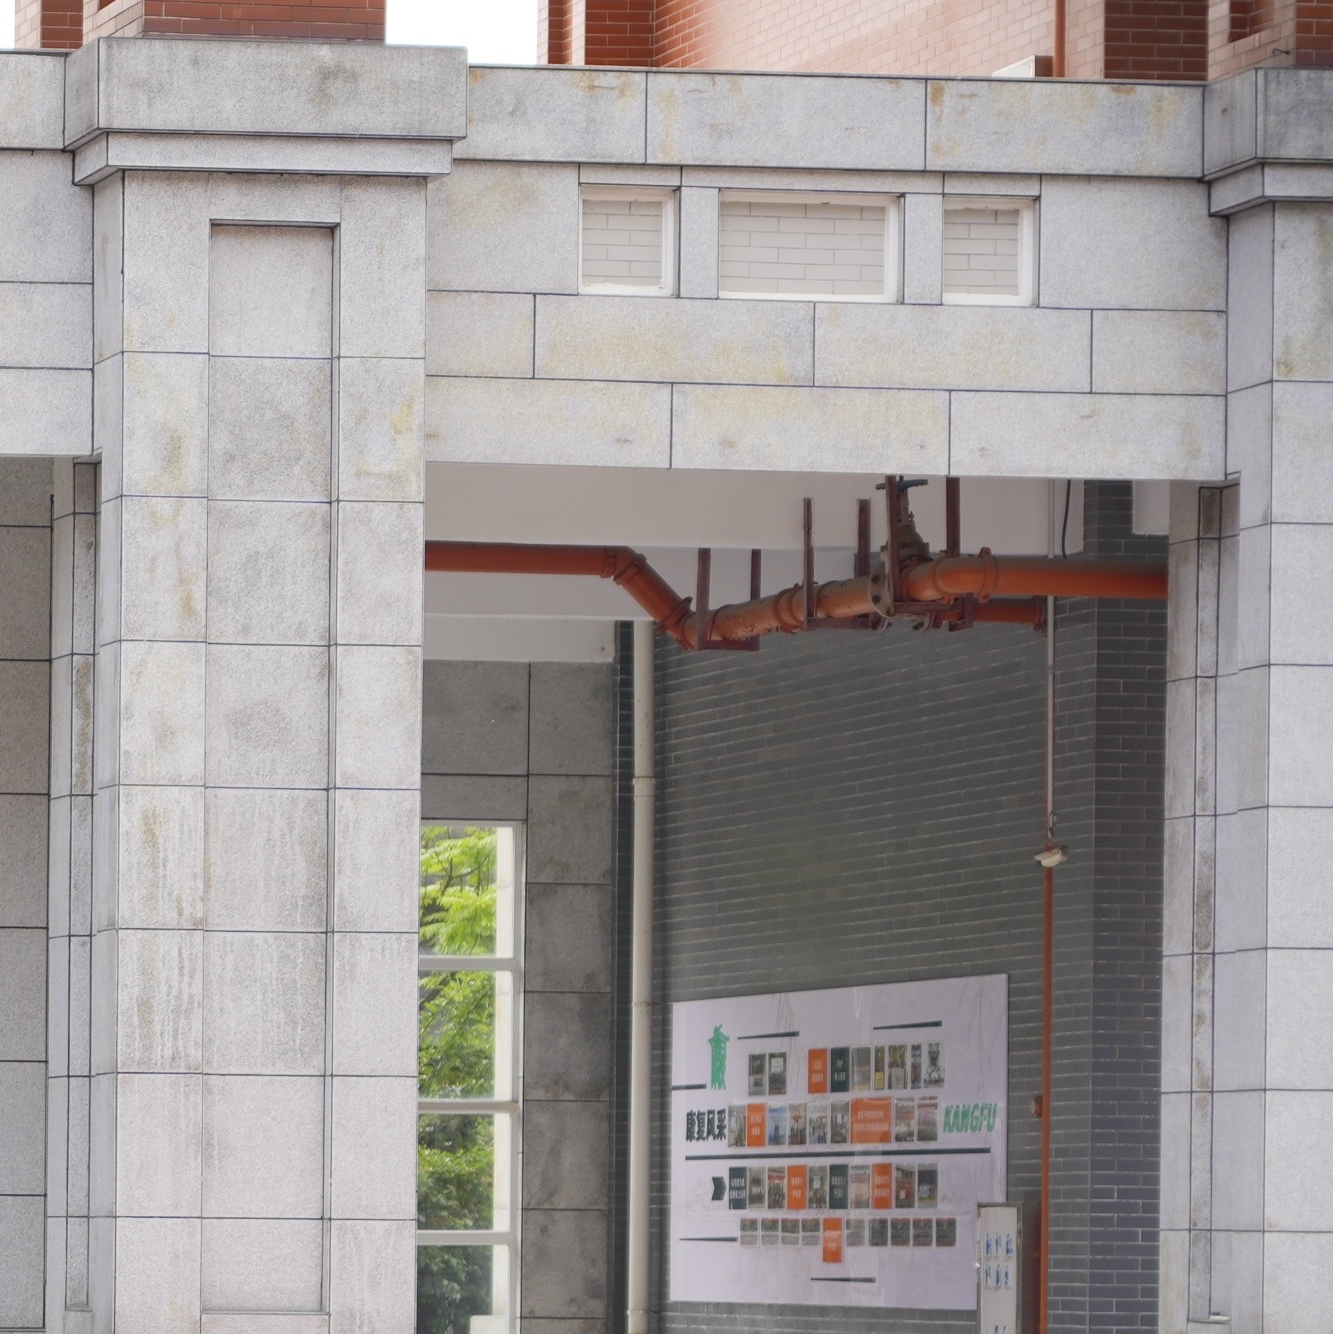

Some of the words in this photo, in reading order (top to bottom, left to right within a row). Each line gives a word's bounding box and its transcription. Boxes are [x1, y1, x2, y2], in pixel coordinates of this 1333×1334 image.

[685, 1109, 727, 1143] 康复风采
[943, 1103, 998, 1134] KANGFU
